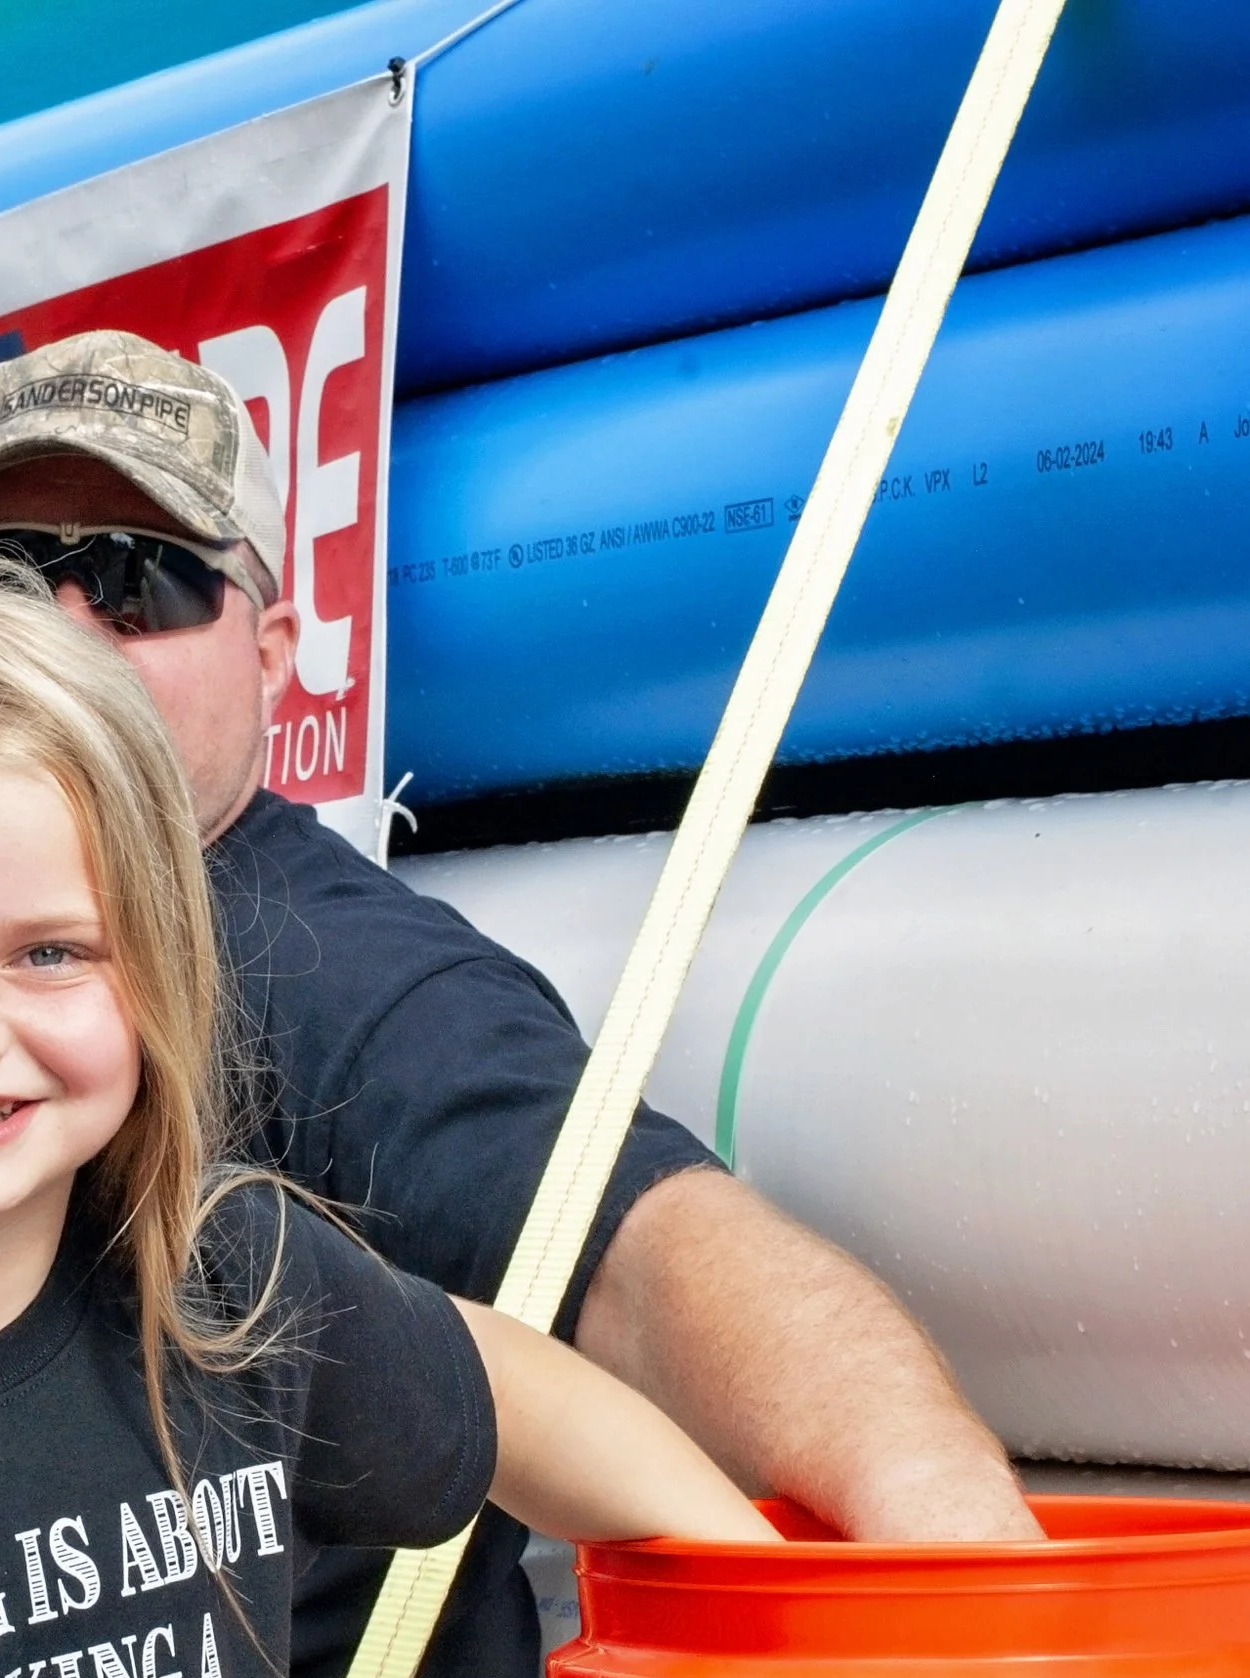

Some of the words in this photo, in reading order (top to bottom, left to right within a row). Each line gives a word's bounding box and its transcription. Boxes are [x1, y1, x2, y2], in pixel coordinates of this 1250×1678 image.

[2, 378, 136, 416] SANDERSON
[139, 393, 188, 429] PIPE
[527, 538, 563, 564] LISTED
[600, 526, 625, 550] ANSI
[633, 521, 671, 545] AWWA
[924, 468, 950, 494] VPX
[972, 462, 988, 486] L2
[1036, 440, 1105, 473] 06-02-2024
[1138, 427, 1173, 454] 19:43
[1198, 421, 1209, 445] A
[14, 1514, 102, 1625] IS
[120, 1460, 288, 1598] ABOUT
